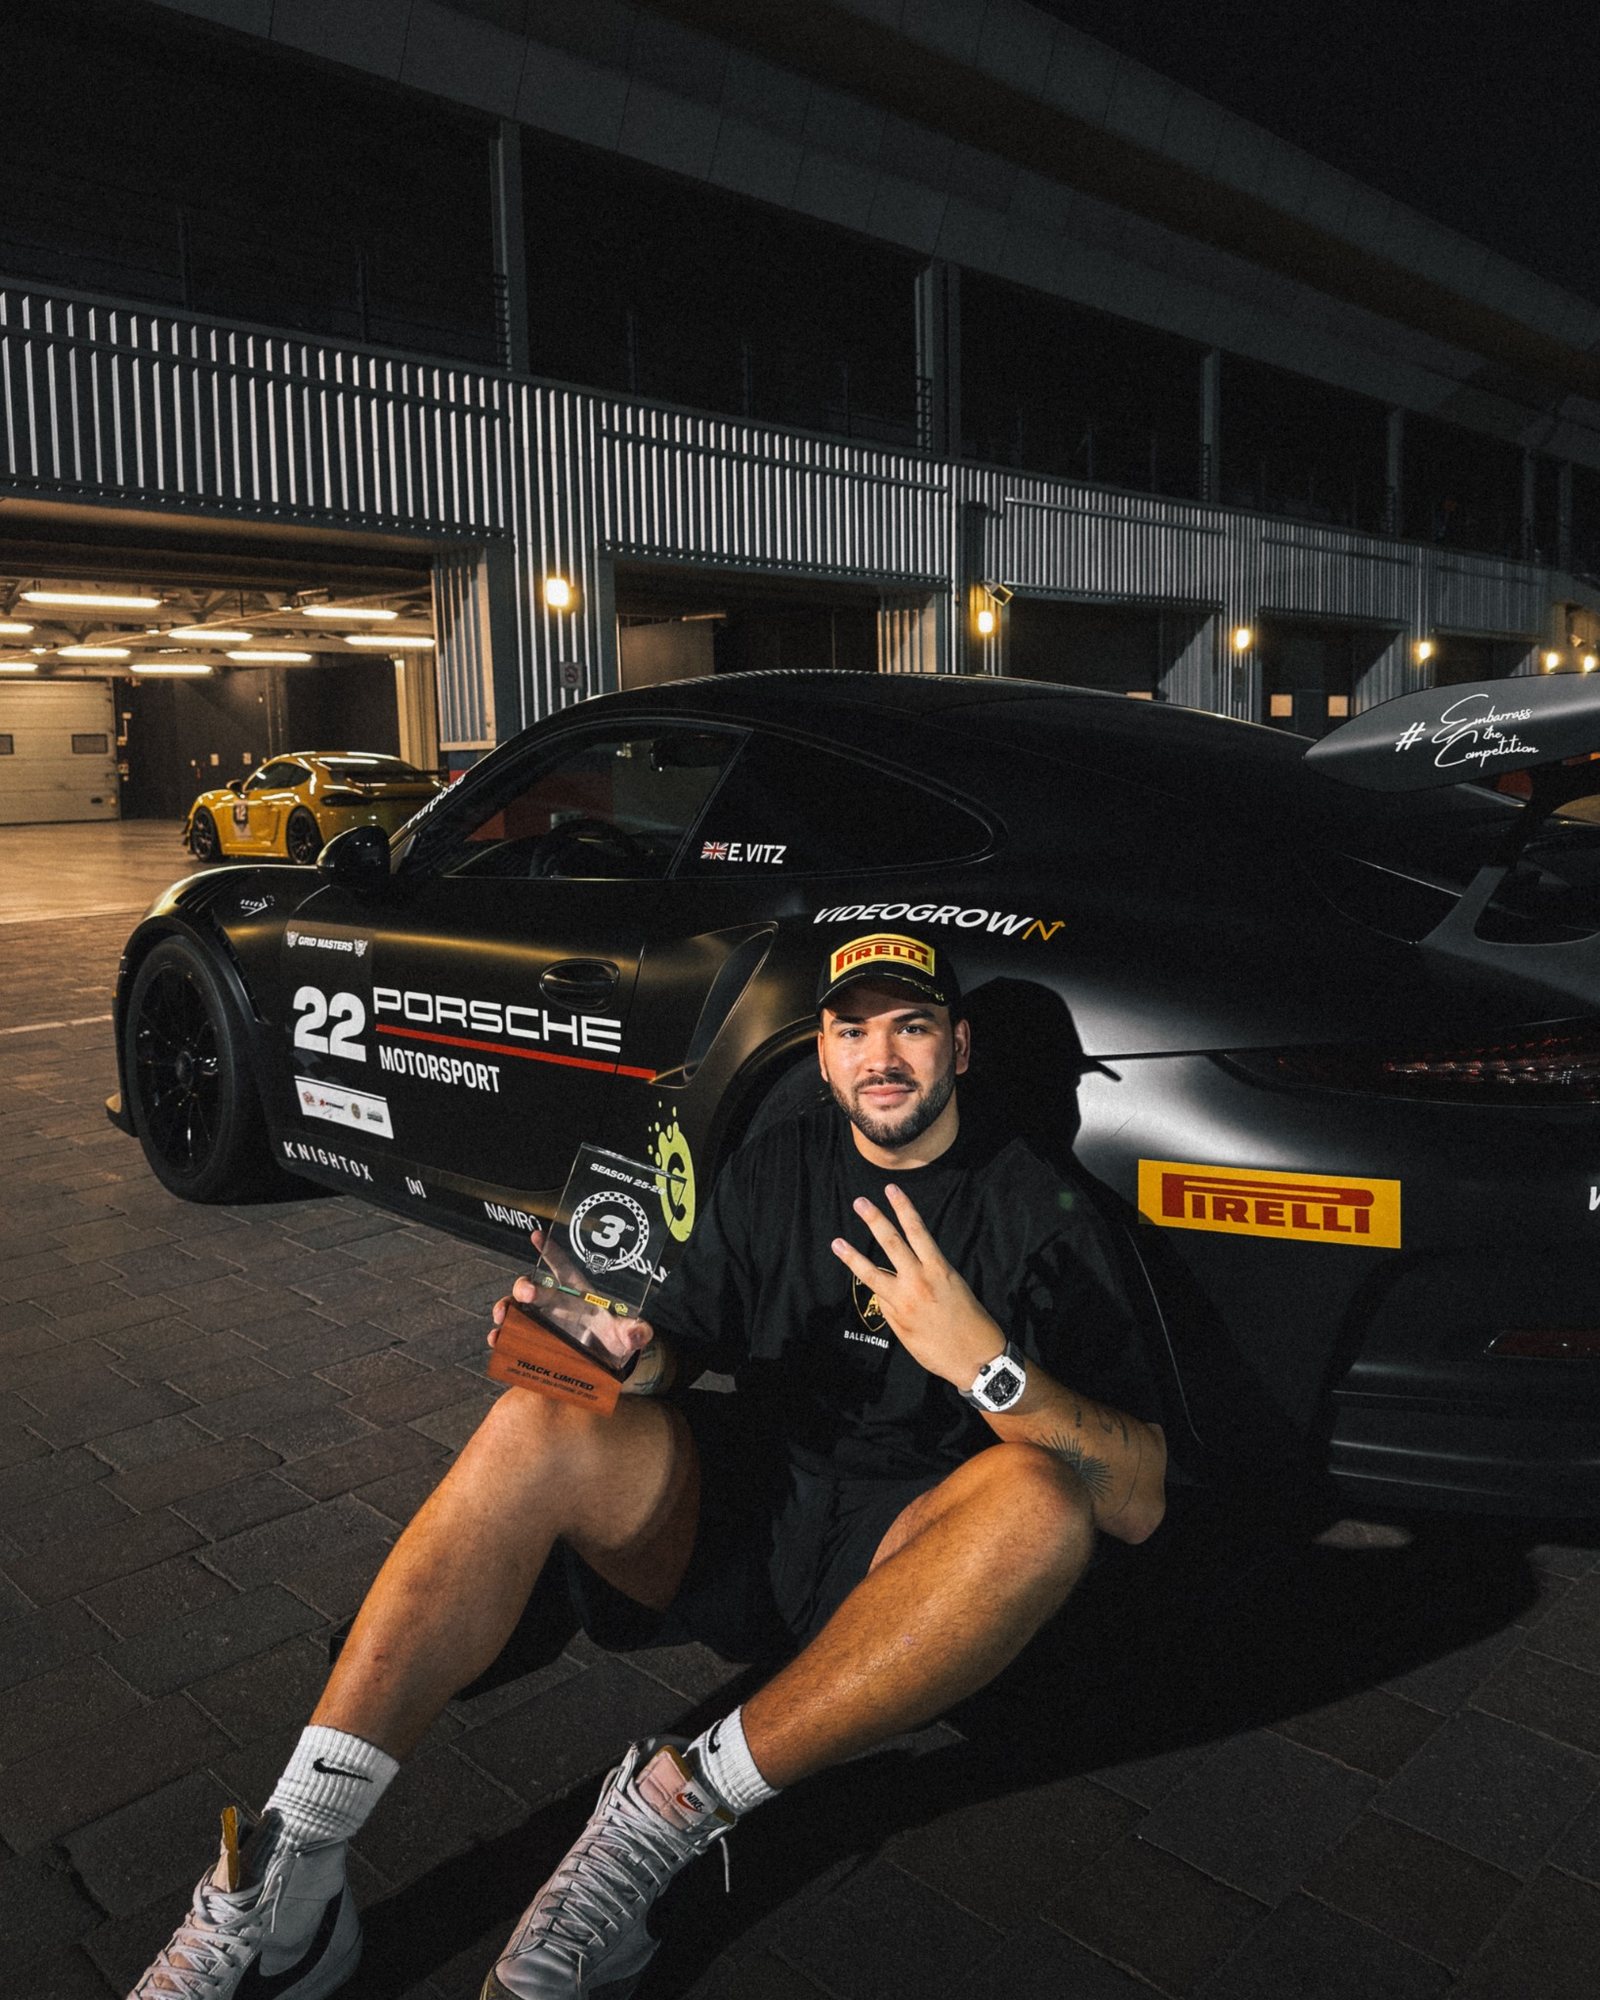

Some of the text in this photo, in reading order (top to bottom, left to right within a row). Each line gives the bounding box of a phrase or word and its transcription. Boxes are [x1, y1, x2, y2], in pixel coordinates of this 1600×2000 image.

[1431, 693, 1533, 744] Embarrass
[1482, 725, 1502, 740] the
[1434, 730, 1539, 768] Competition
[727, 842, 787, 864] E.VITZ
[813, 902, 1066, 941] VIDEOGROWN
[298, 935, 354, 952] GRID MASTERS
[835, 937, 929, 974] PIRELLI
[292, 985, 367, 1062] 22
[373, 986, 622, 1053] PORSCHE
[378, 1045, 500, 1093] MOTORSPORT
[283, 1141, 374, 1182] KNIGHTOX
[590, 1162, 633, 1184] SEASON
[1161, 1172, 1375, 1234] PIRELLI
[517, 1360, 552, 1377] TRACK
[553, 1372, 595, 1391] LIMITED
[684, 1791, 705, 1811] NIKE
